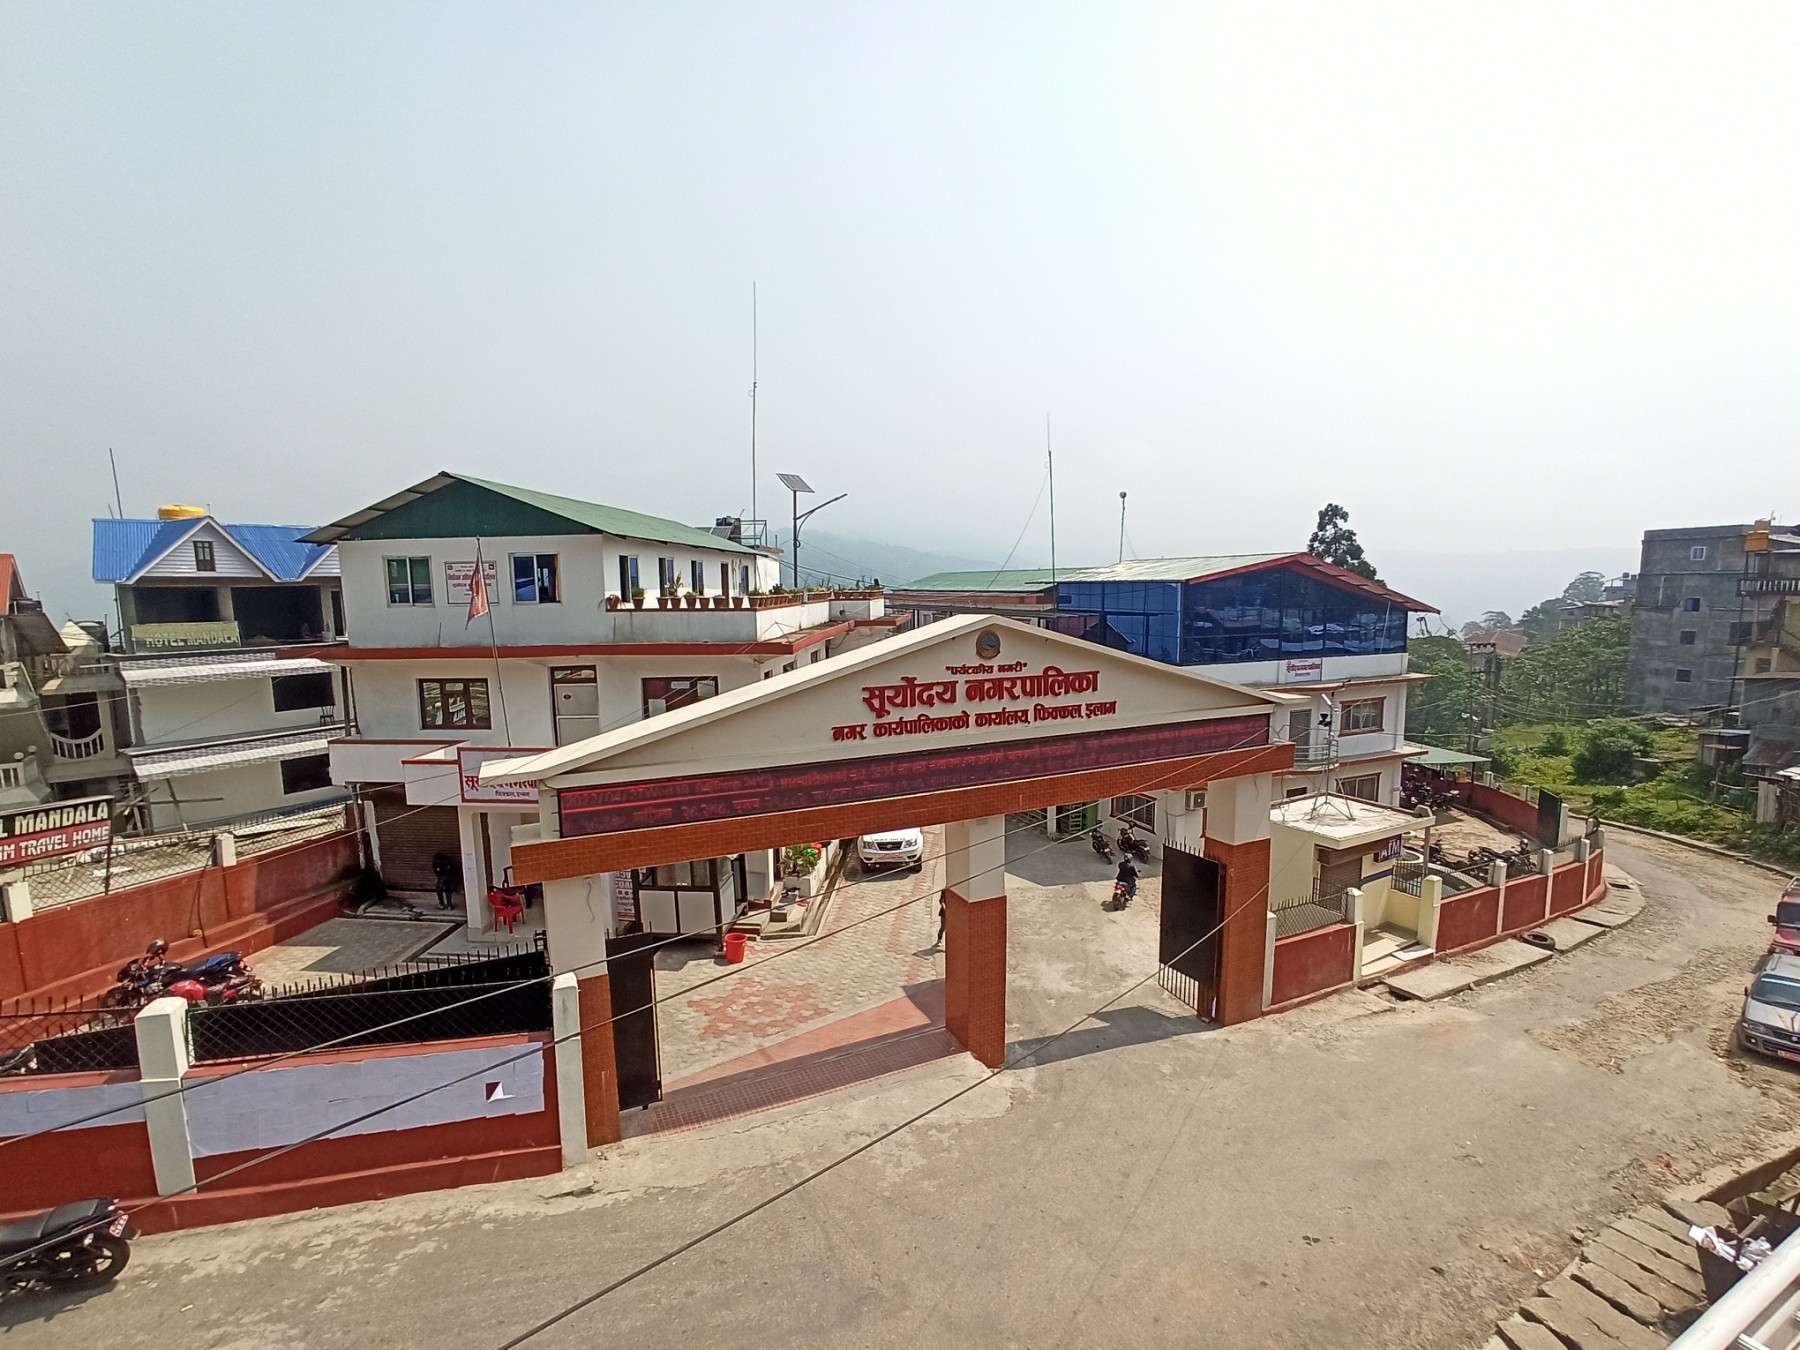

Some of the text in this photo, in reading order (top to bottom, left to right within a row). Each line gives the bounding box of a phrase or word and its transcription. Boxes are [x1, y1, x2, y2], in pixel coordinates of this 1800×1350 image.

[146, 632, 185, 648] HOTEL
[862, 665, 1100, 719] सूर्योदय नगरपालिका
[831, 723, 868, 741] नगर
[872, 710, 970, 737] कार्यपालिकाको
[1085, 701, 1117, 719] इलाम
[14, 802, 109, 836] MANDALA
[19, 834, 69, 857] TRAVEL
[73, 826, 110, 848] HOME
[1380, 839, 1400, 859] ATM
